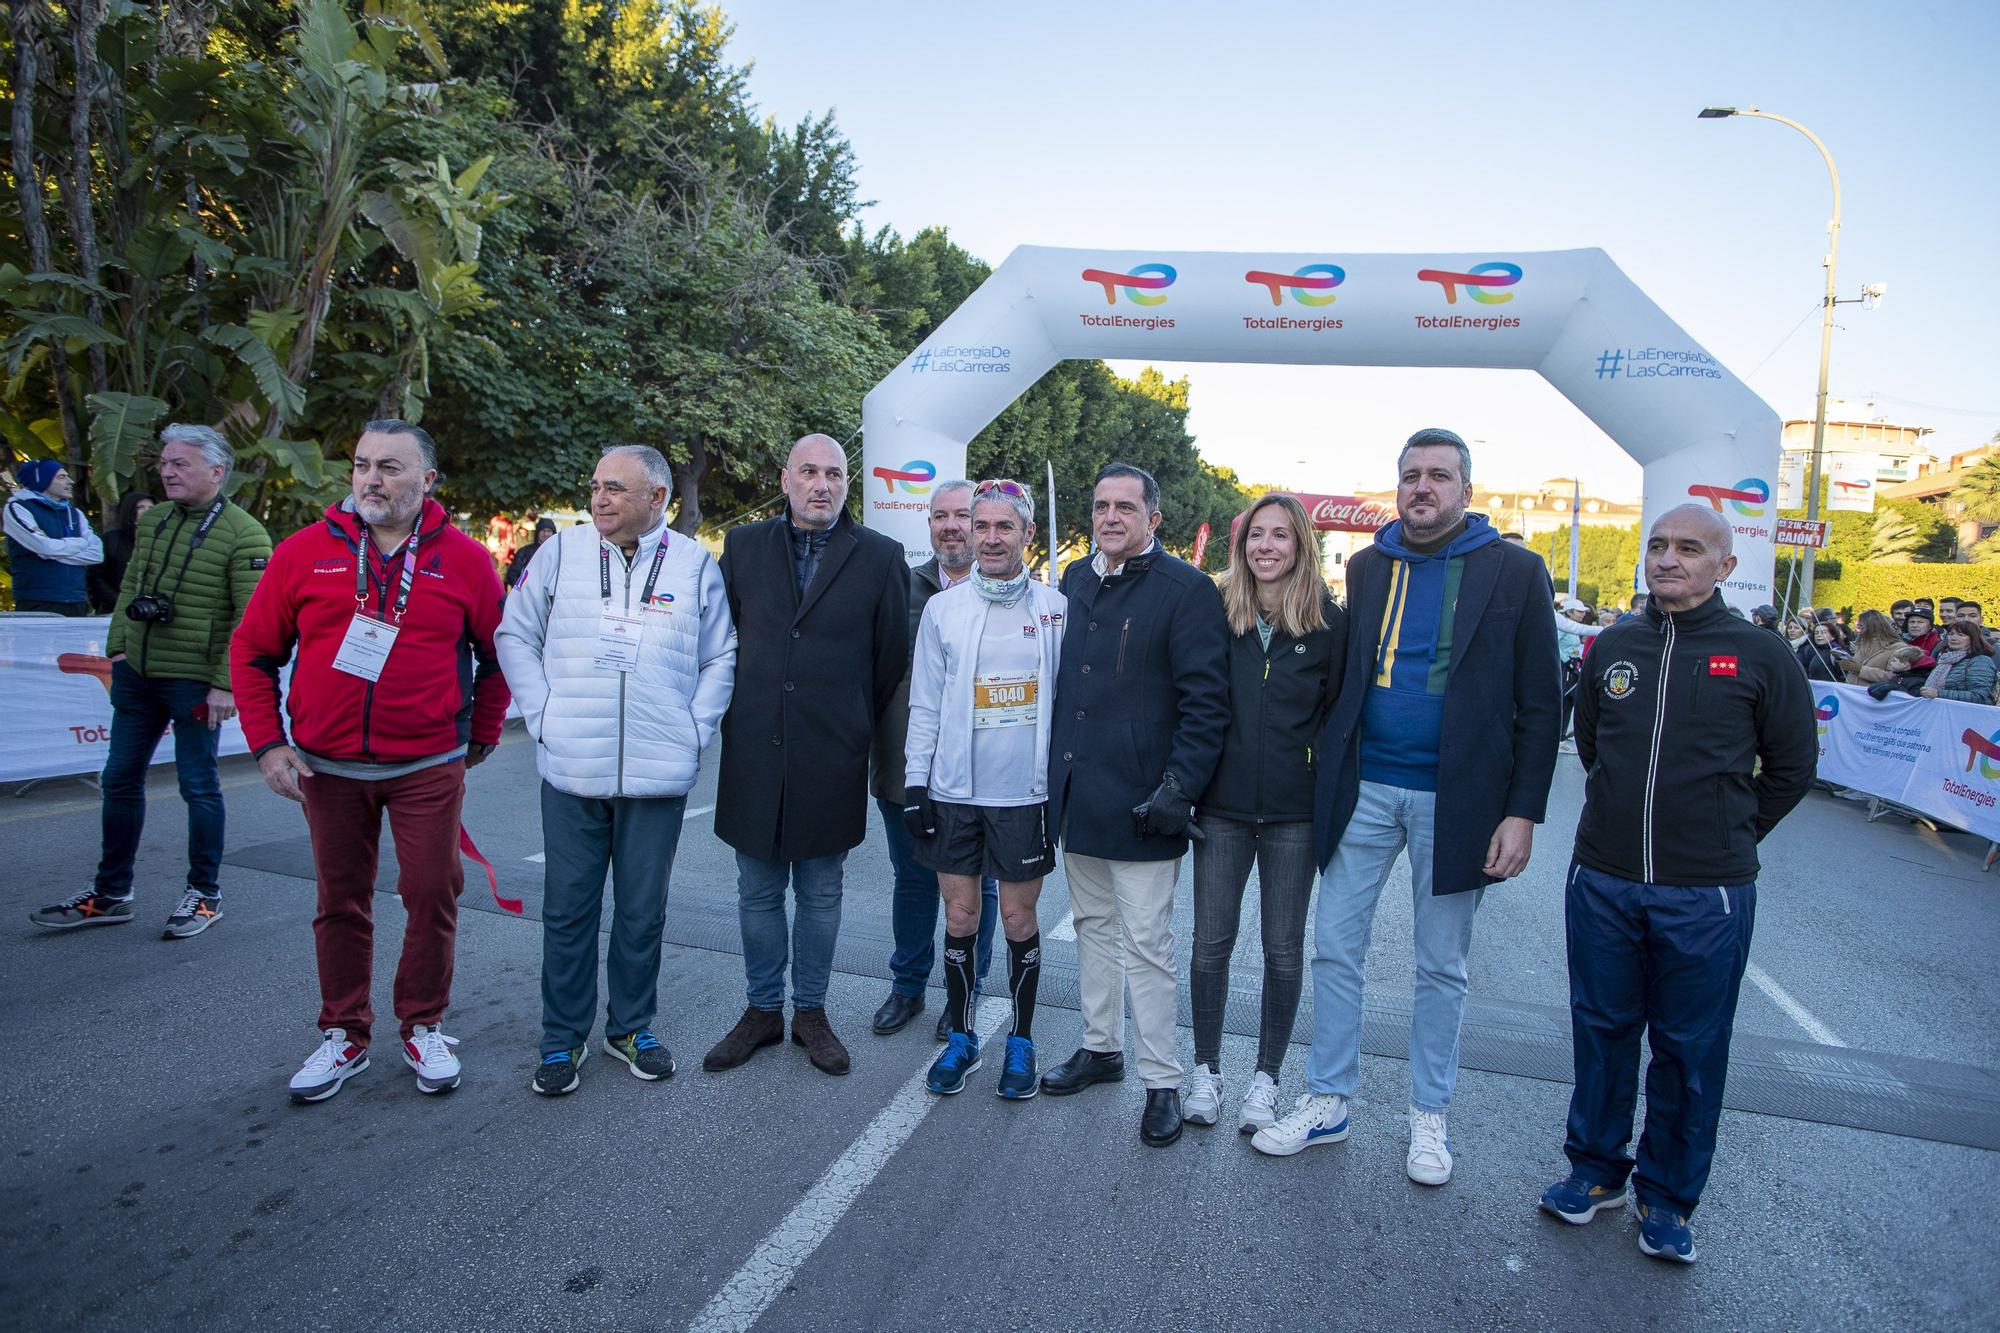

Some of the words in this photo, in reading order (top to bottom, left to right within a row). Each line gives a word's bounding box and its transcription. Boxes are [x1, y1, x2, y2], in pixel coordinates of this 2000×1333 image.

[1080, 314, 1175, 331] TotalEnergies
[1243, 316, 1343, 332] TotalEnergies
[1415, 314, 1520, 331] TotalEnergies
[931, 359, 1010, 373] LasCarreras
[1627, 363, 1721, 379] LasCarreras
[873, 501, 929, 512] TotalEnergi
[1732, 526, 1769, 538] nergies
[1778, 531, 1813, 545] CAJÓN
[359, 538, 367, 574] ANIVERSARIO
[648, 557, 662, 587] ANIVERSARIO
[989, 687, 1025, 704] 5040
[1942, 777, 1996, 808] TotalEnergies
